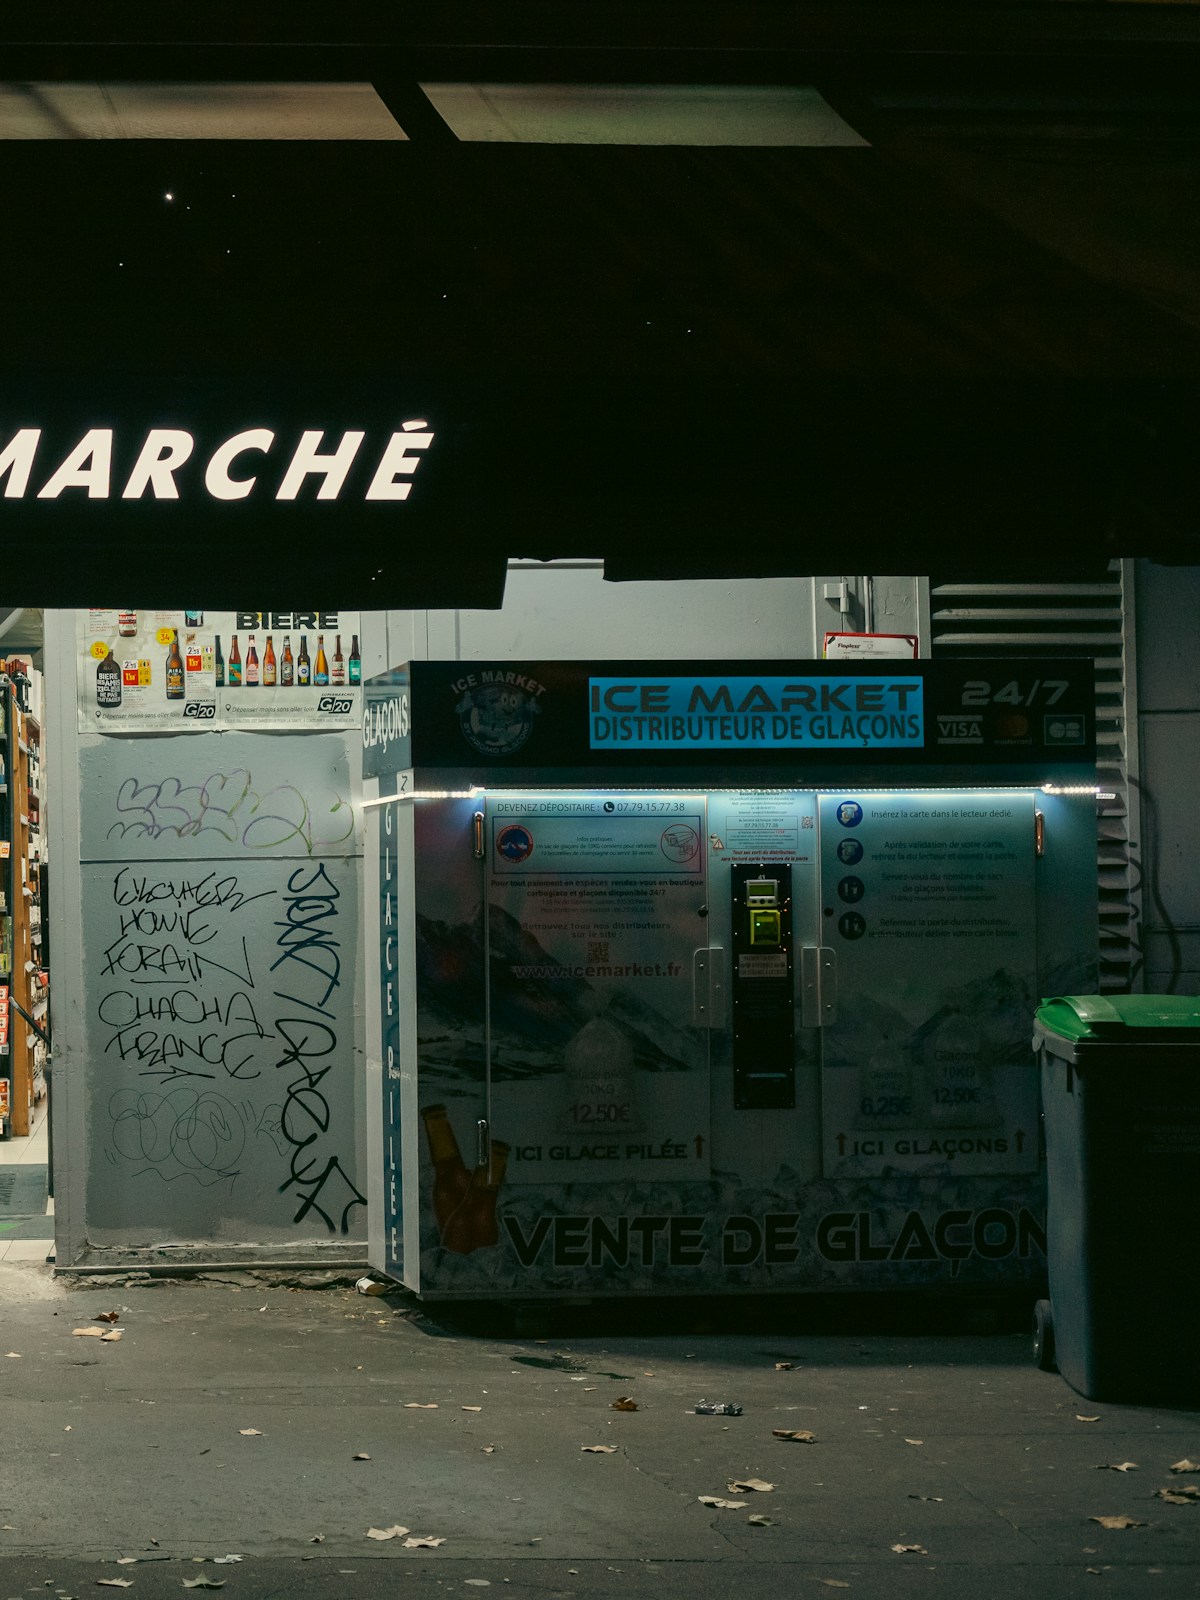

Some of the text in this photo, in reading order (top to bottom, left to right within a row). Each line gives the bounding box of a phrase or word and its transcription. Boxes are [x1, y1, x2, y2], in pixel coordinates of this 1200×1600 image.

[450, 670, 547, 697] ICE MARKET
[961, 679, 1070, 707] 24/7
[591, 684, 920, 713] ICE MARKET
[232, 706, 258, 715] Dépenser
[276, 705, 289, 713] sans
[362, 694, 409, 754] GLAÇONS
[594, 713, 920, 747] DISTRIBUTEUR DE GLAÇONS
[938, 721, 982, 737] VISA
[497, 800, 685, 812] DEVENEZ DÉPOSITAIRE 07.79.15.77.38
[871, 809, 899, 819] Insérez
[900, 809, 908, 818] la
[909, 810, 930, 819] carte
[931, 809, 950, 818] dans
[951, 809, 960, 818] le
[960, 809, 988, 818] lecteur
[884, 840, 907, 851] Après
[909, 840, 948, 849] validation
[949, 840, 960, 849] de
[510, 880, 526, 889] tout
[527, 879, 564, 891] paiement
[565, 881, 574, 889] en
[575, 878, 608, 891] espèces
[611, 879, 657, 889] rendez-vous
[659, 880, 668, 889] en
[669, 879, 703, 891] boutique
[608, 889, 648, 900] disponible
[649, 889, 666, 898] 24/7
[522, 921, 671, 931] Retrouvez tous nos distributeurs
[513, 962, 682, 979] www.icemarket.fr
[98, 990, 264, 1040] CHACHA
[515, 1138, 688, 1161] ICI GLACE PILÉE
[852, 1139, 1009, 1160] ICI GLAÇONS
[500, 1214, 714, 1268] VENTE
[720, 1212, 801, 1268] DE
